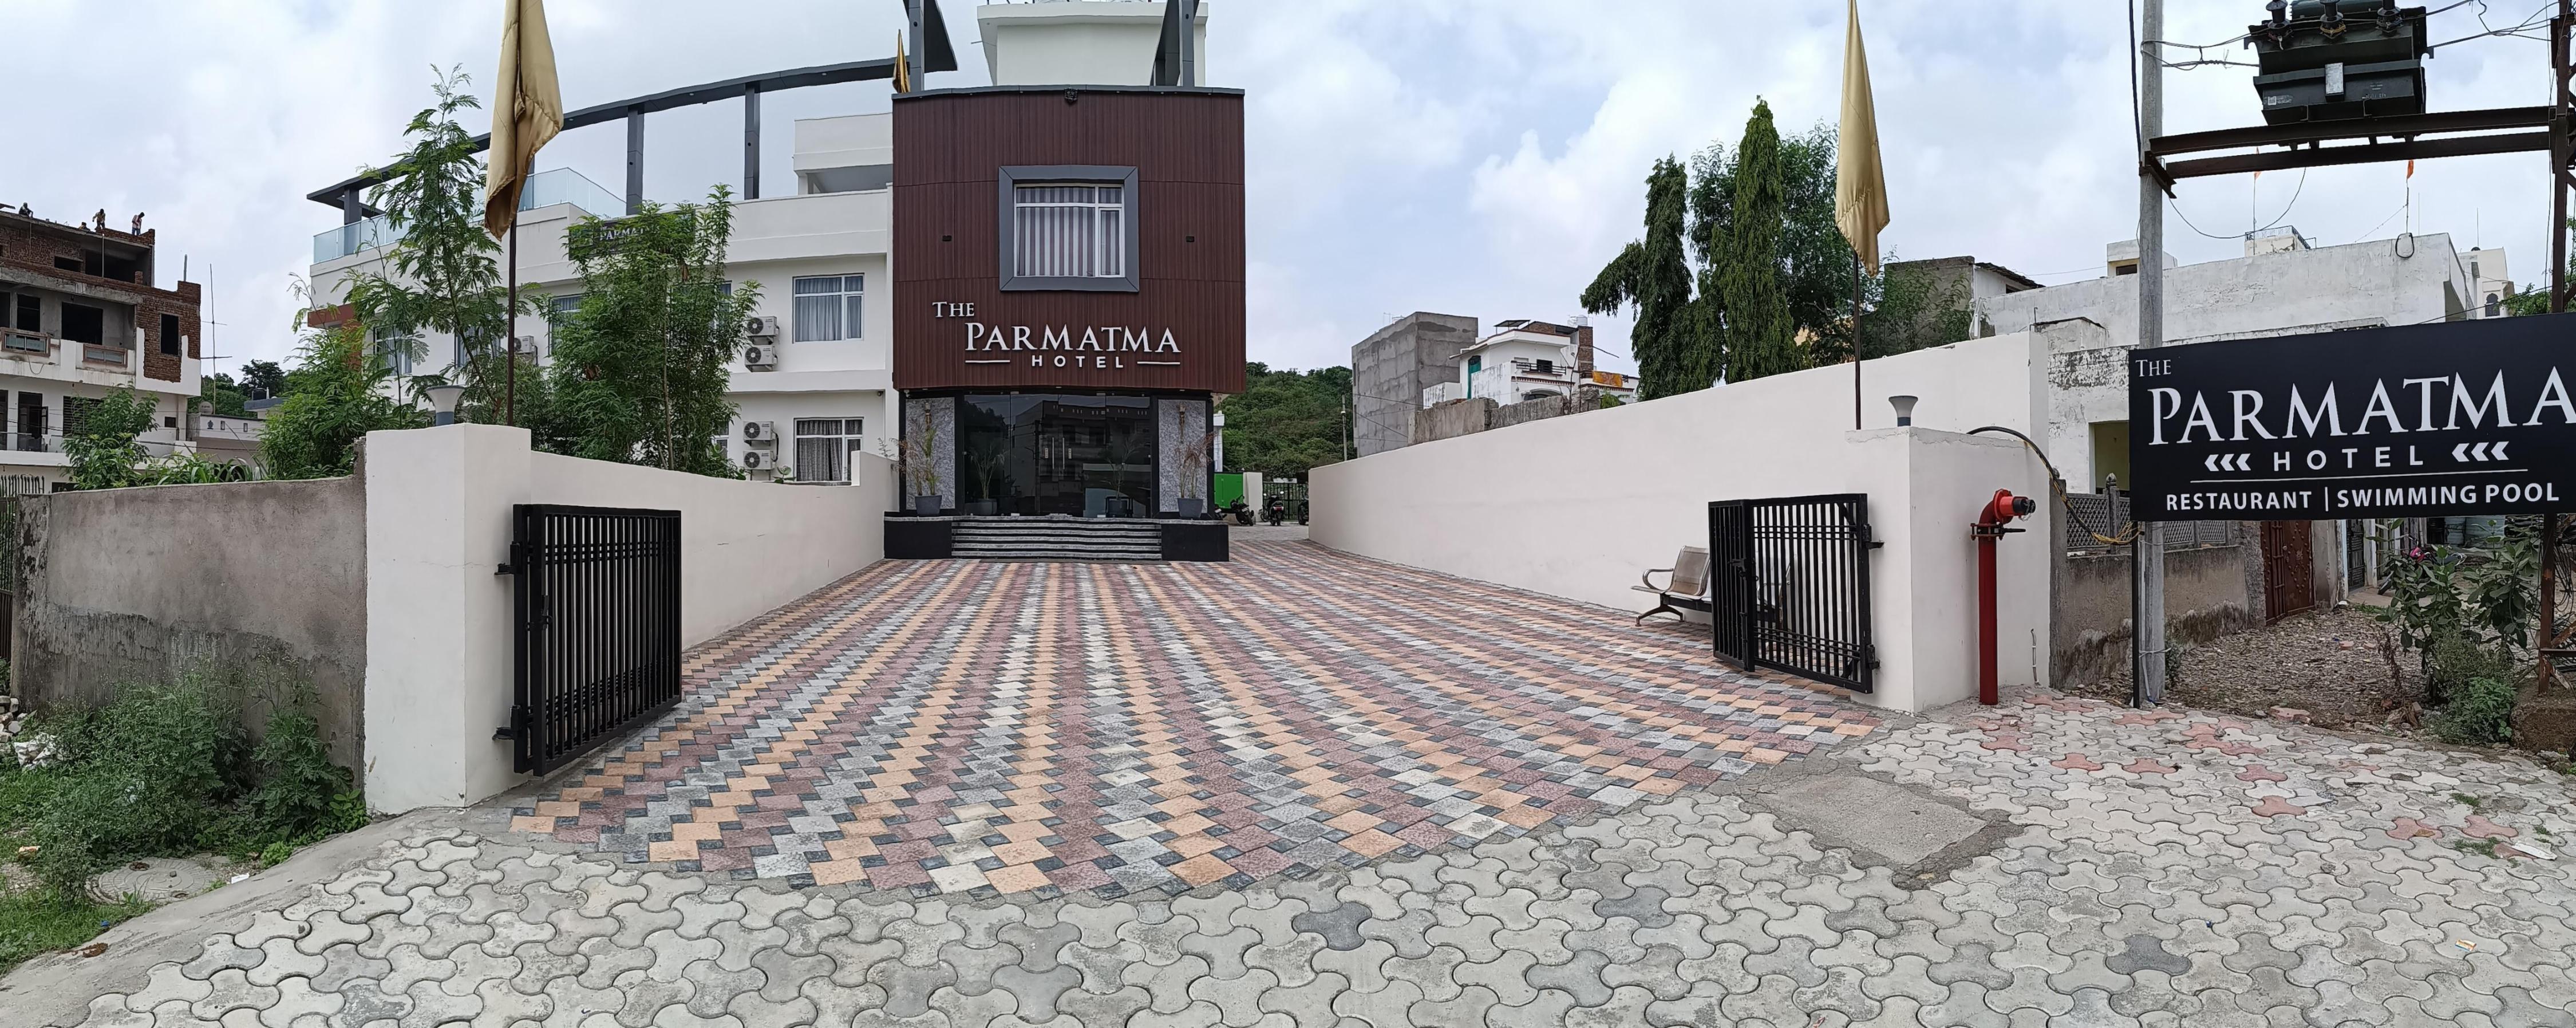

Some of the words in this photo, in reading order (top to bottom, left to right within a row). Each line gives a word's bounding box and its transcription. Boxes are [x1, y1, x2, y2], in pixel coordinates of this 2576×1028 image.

[932, 301, 974, 317] THE
[965, 322, 1182, 353] PARMATMA
[1032, 355, 1124, 368] HOTEL
[2136, 359, 2172, 377] THE
[2148, 366, 2576, 446] PARMATMA
[2273, 445, 2424, 472] HOTEL
[2166, 489, 2313, 511] RESTAURANT
[2337, 483, 2477, 507] SWIMMING
[2486, 482, 2559, 503] POOL
